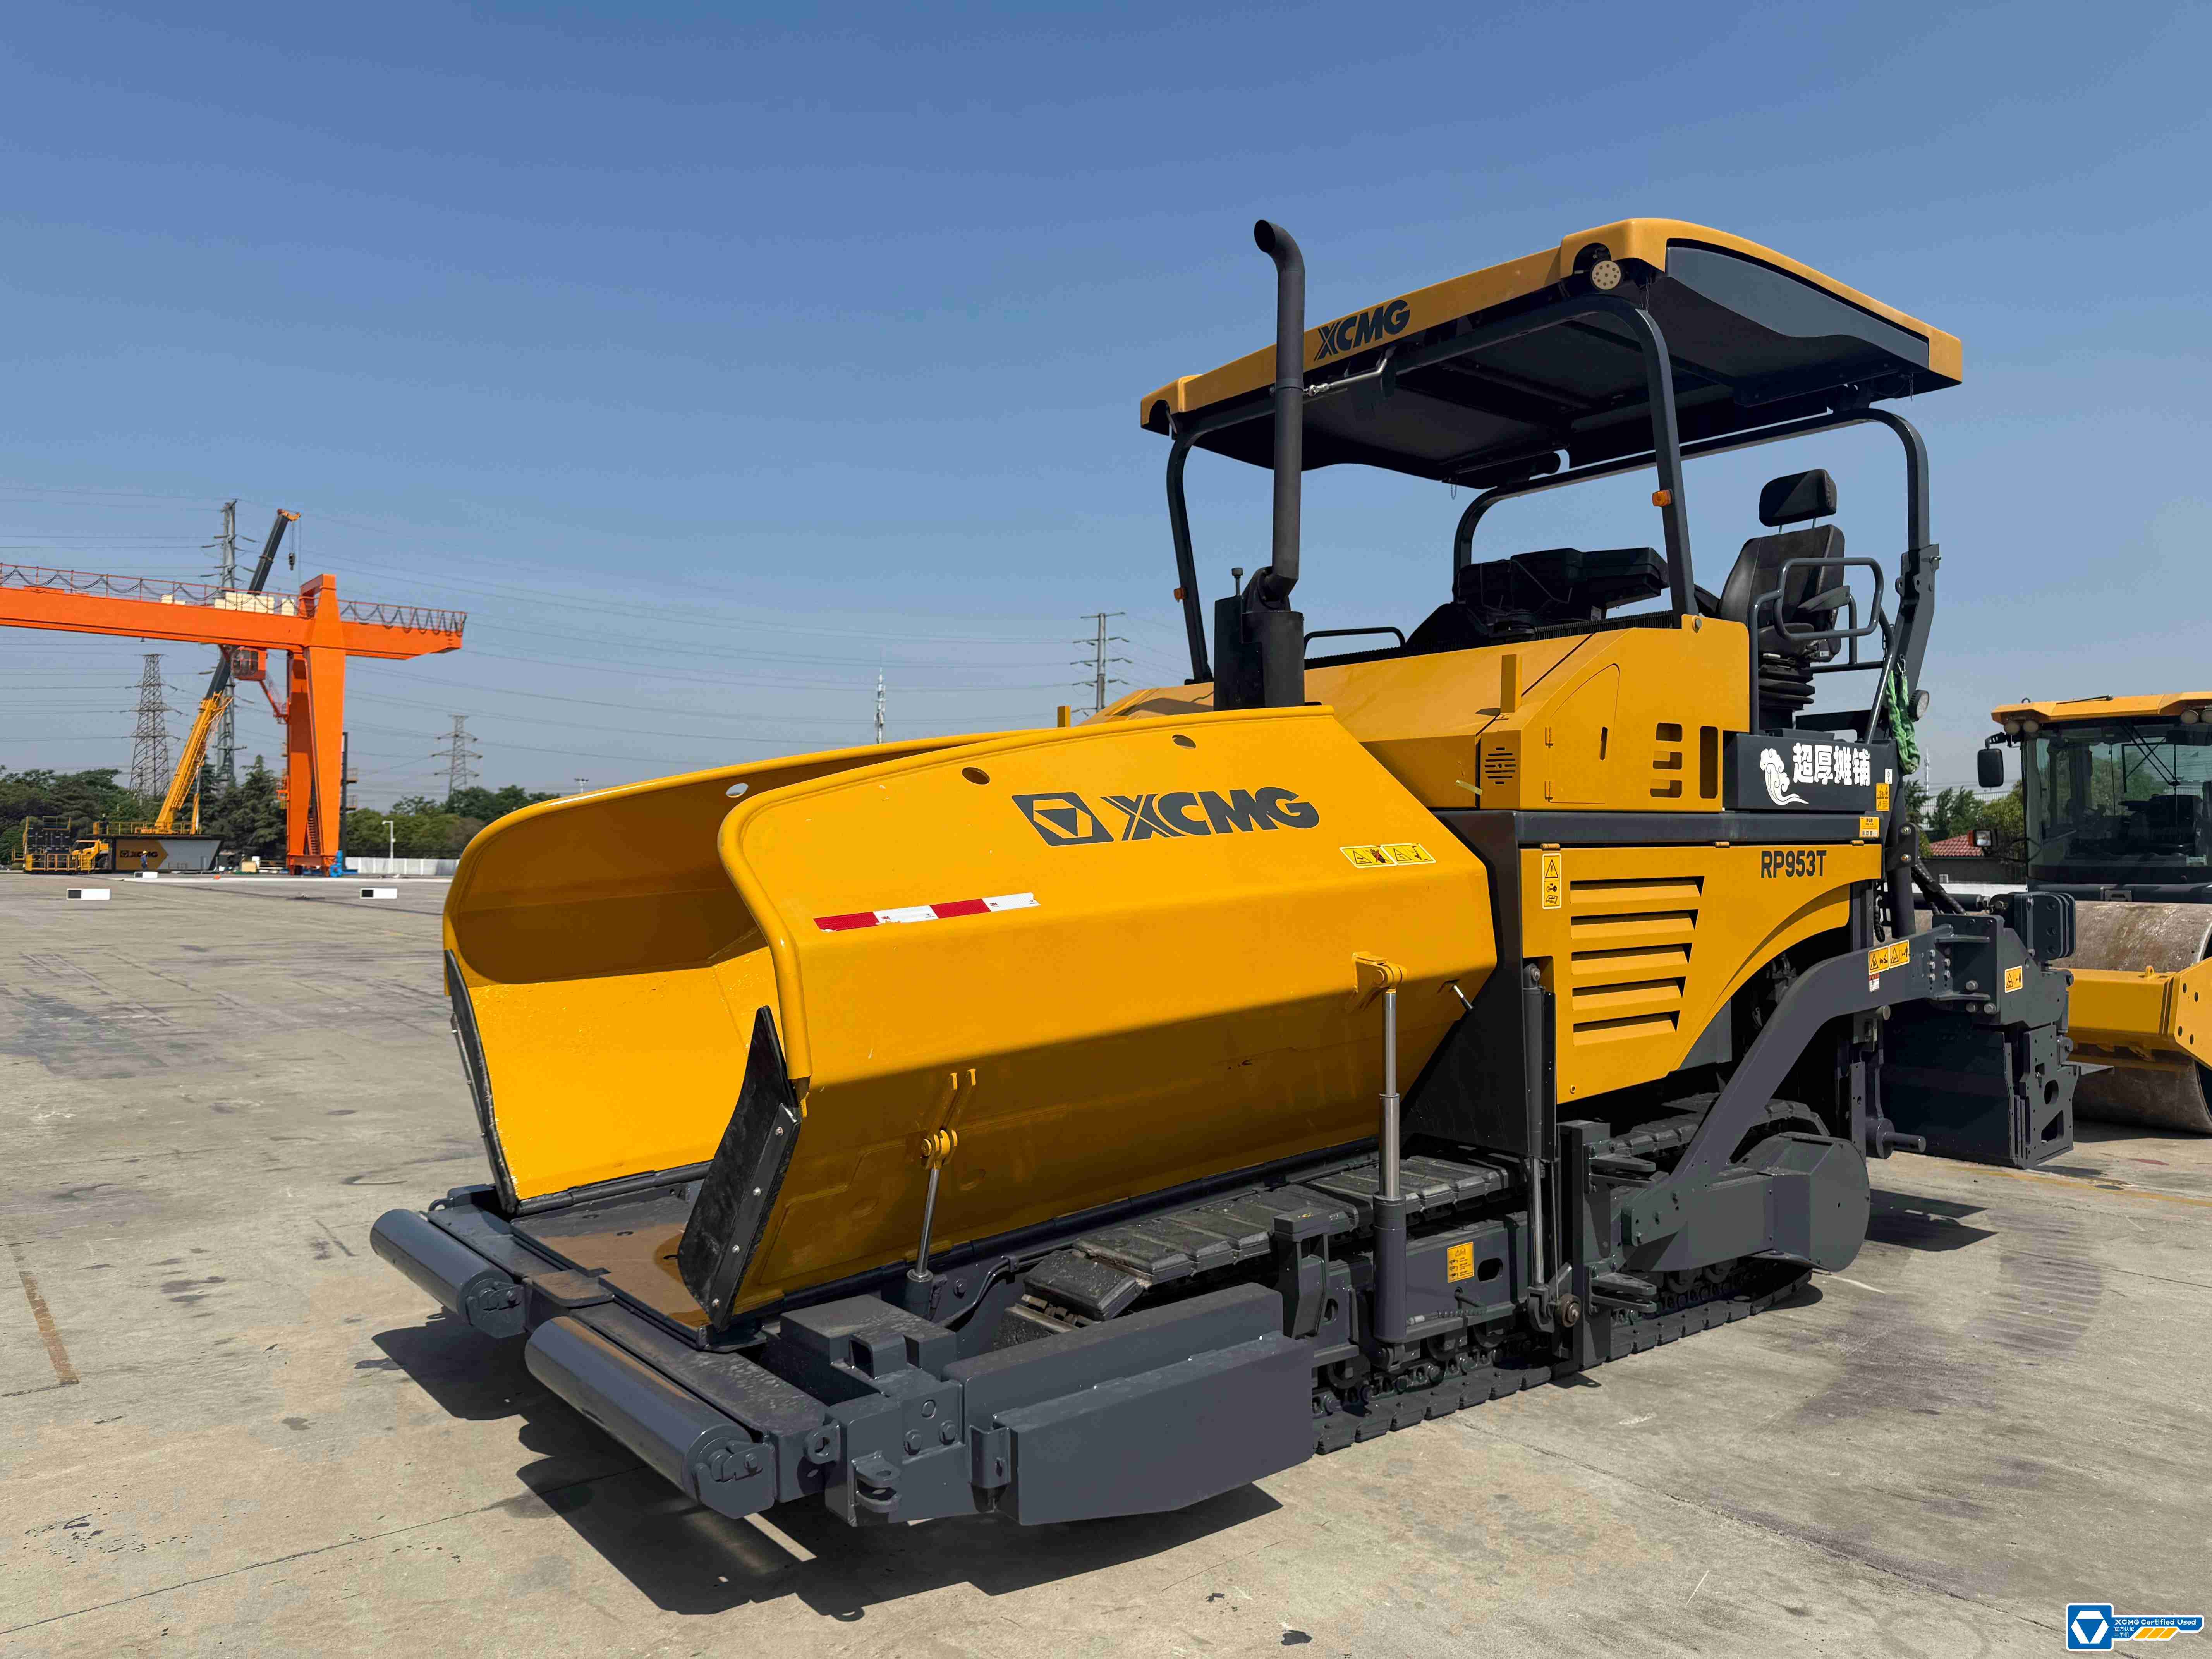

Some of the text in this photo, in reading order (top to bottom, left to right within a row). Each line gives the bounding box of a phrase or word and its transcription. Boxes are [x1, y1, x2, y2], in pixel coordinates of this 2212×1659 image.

[1314, 299, 1410, 361] XCMG
[1793, 742, 1870, 786] 超厚摊铺
[1099, 787, 1319, 841] XCMG
[1761, 850, 1827, 878] RP953T
